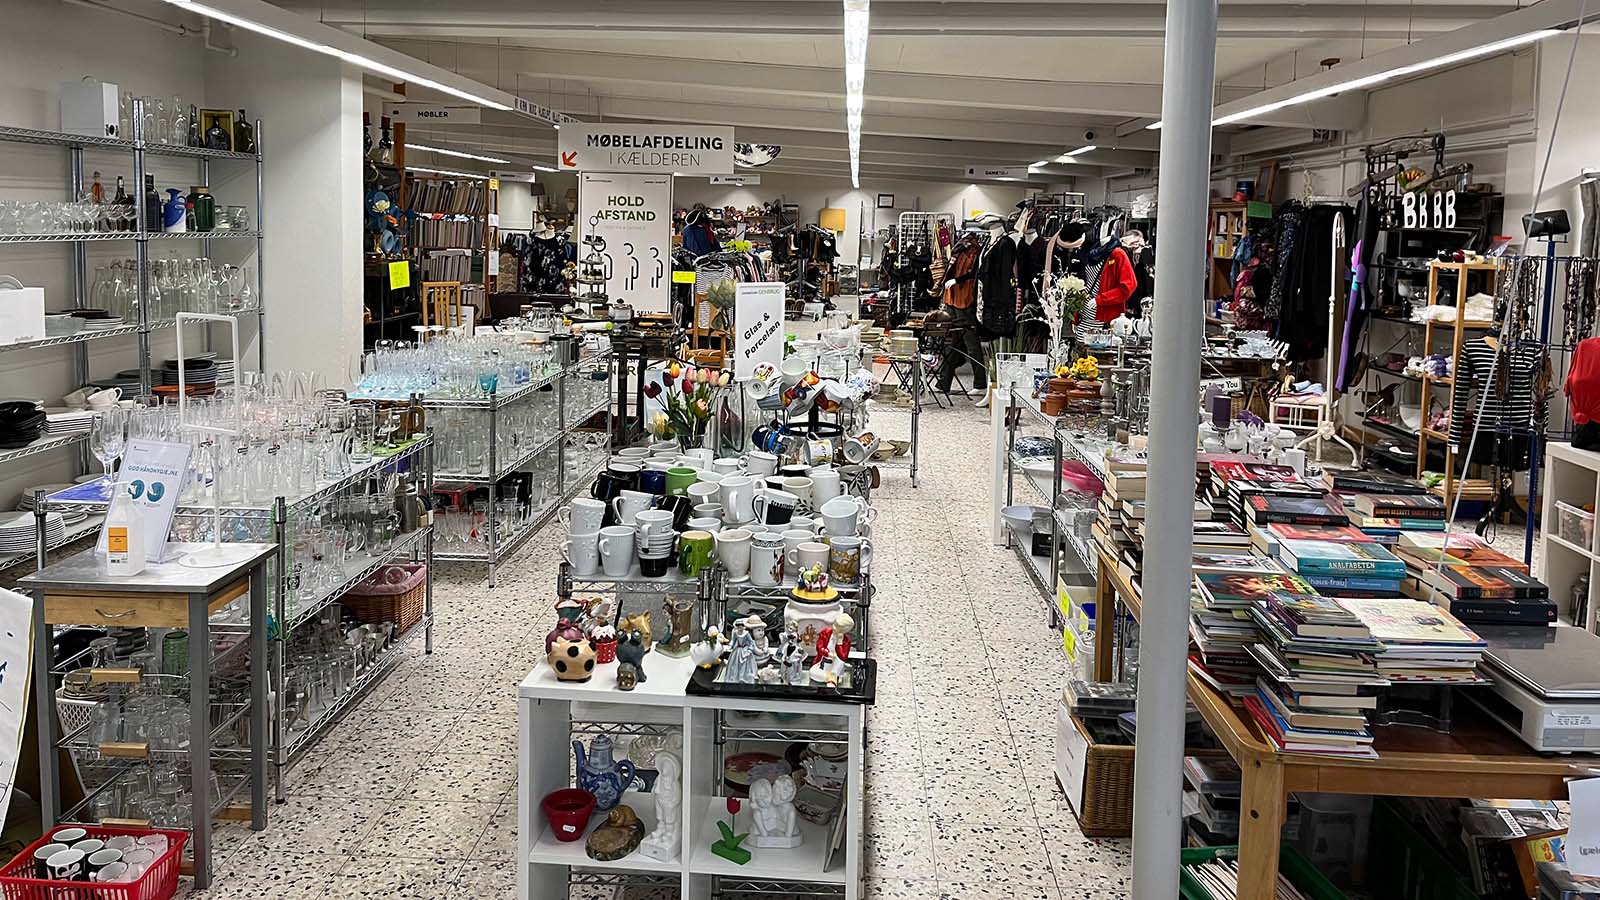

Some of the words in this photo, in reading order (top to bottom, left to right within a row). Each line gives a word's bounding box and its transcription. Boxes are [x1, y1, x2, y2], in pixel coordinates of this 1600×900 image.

[586, 134, 723, 150] MØBELAFDELING
[609, 152, 613, 165] I
[617, 152, 701, 167] KÆLDEREN
[607, 195, 645, 207] HOLD
[596, 210, 656, 221] AFSTAND
[743, 320, 763, 341] Glas
[762, 312, 771, 322] &
[744, 320, 781, 359] Porcelæn
[1225, 380, 1239, 389] You
[1328, 561, 1376, 570] ANALFABETEN
